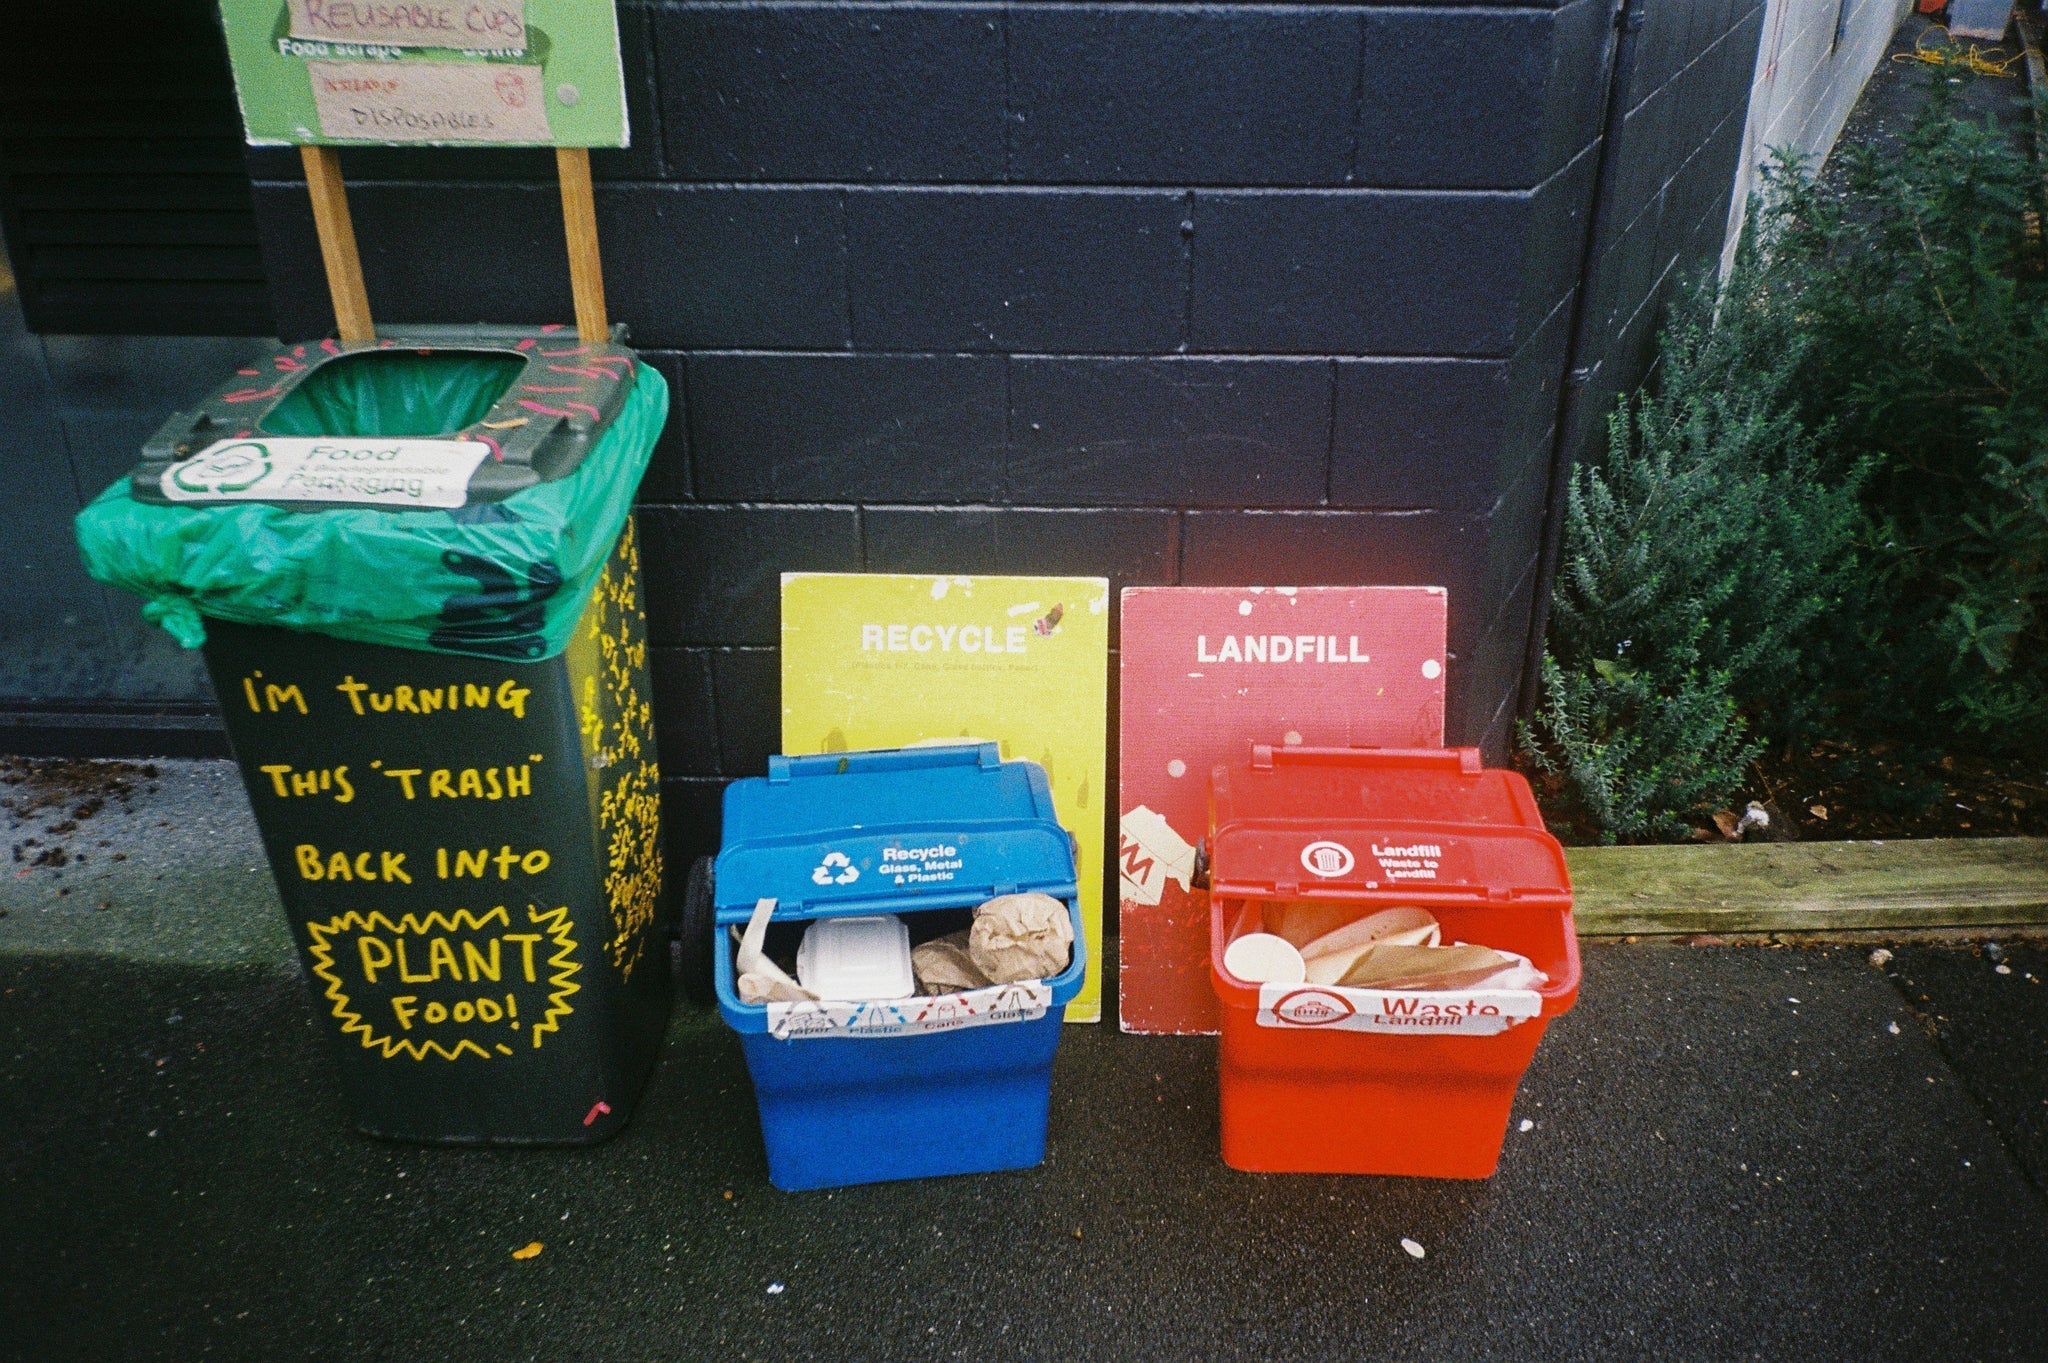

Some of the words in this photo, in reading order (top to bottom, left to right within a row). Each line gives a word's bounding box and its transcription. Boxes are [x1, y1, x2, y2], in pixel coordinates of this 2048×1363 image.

[305, 0, 457, 30] REUSABLE
[278, 39, 329, 56] Food
[306, 446, 401, 461] Food
[282, 474, 424, 498] Packaging
[861, 623, 1027, 653] RECYCLE
[1197, 635, 1370, 663] LANDFILL
[260, 764, 355, 803] THIS
[883, 843, 957, 861] Recycle
[1371, 843, 1442, 857] Landfill
[295, 844, 412, 884] BACK
[879, 864, 921, 875] Glass,
[924, 859, 963, 871] Metal
[1378, 858, 1421, 868] Waste
[1423, 859, 1439, 868] to
[1385, 868, 1436, 878] Landfill
[894, 873, 905, 884] &
[907, 872, 954, 883] Plastic
[357, 933, 543, 983] PLANT
[391, 994, 518, 1030] FOOD!
[1382, 997, 1500, 1017] Waste
